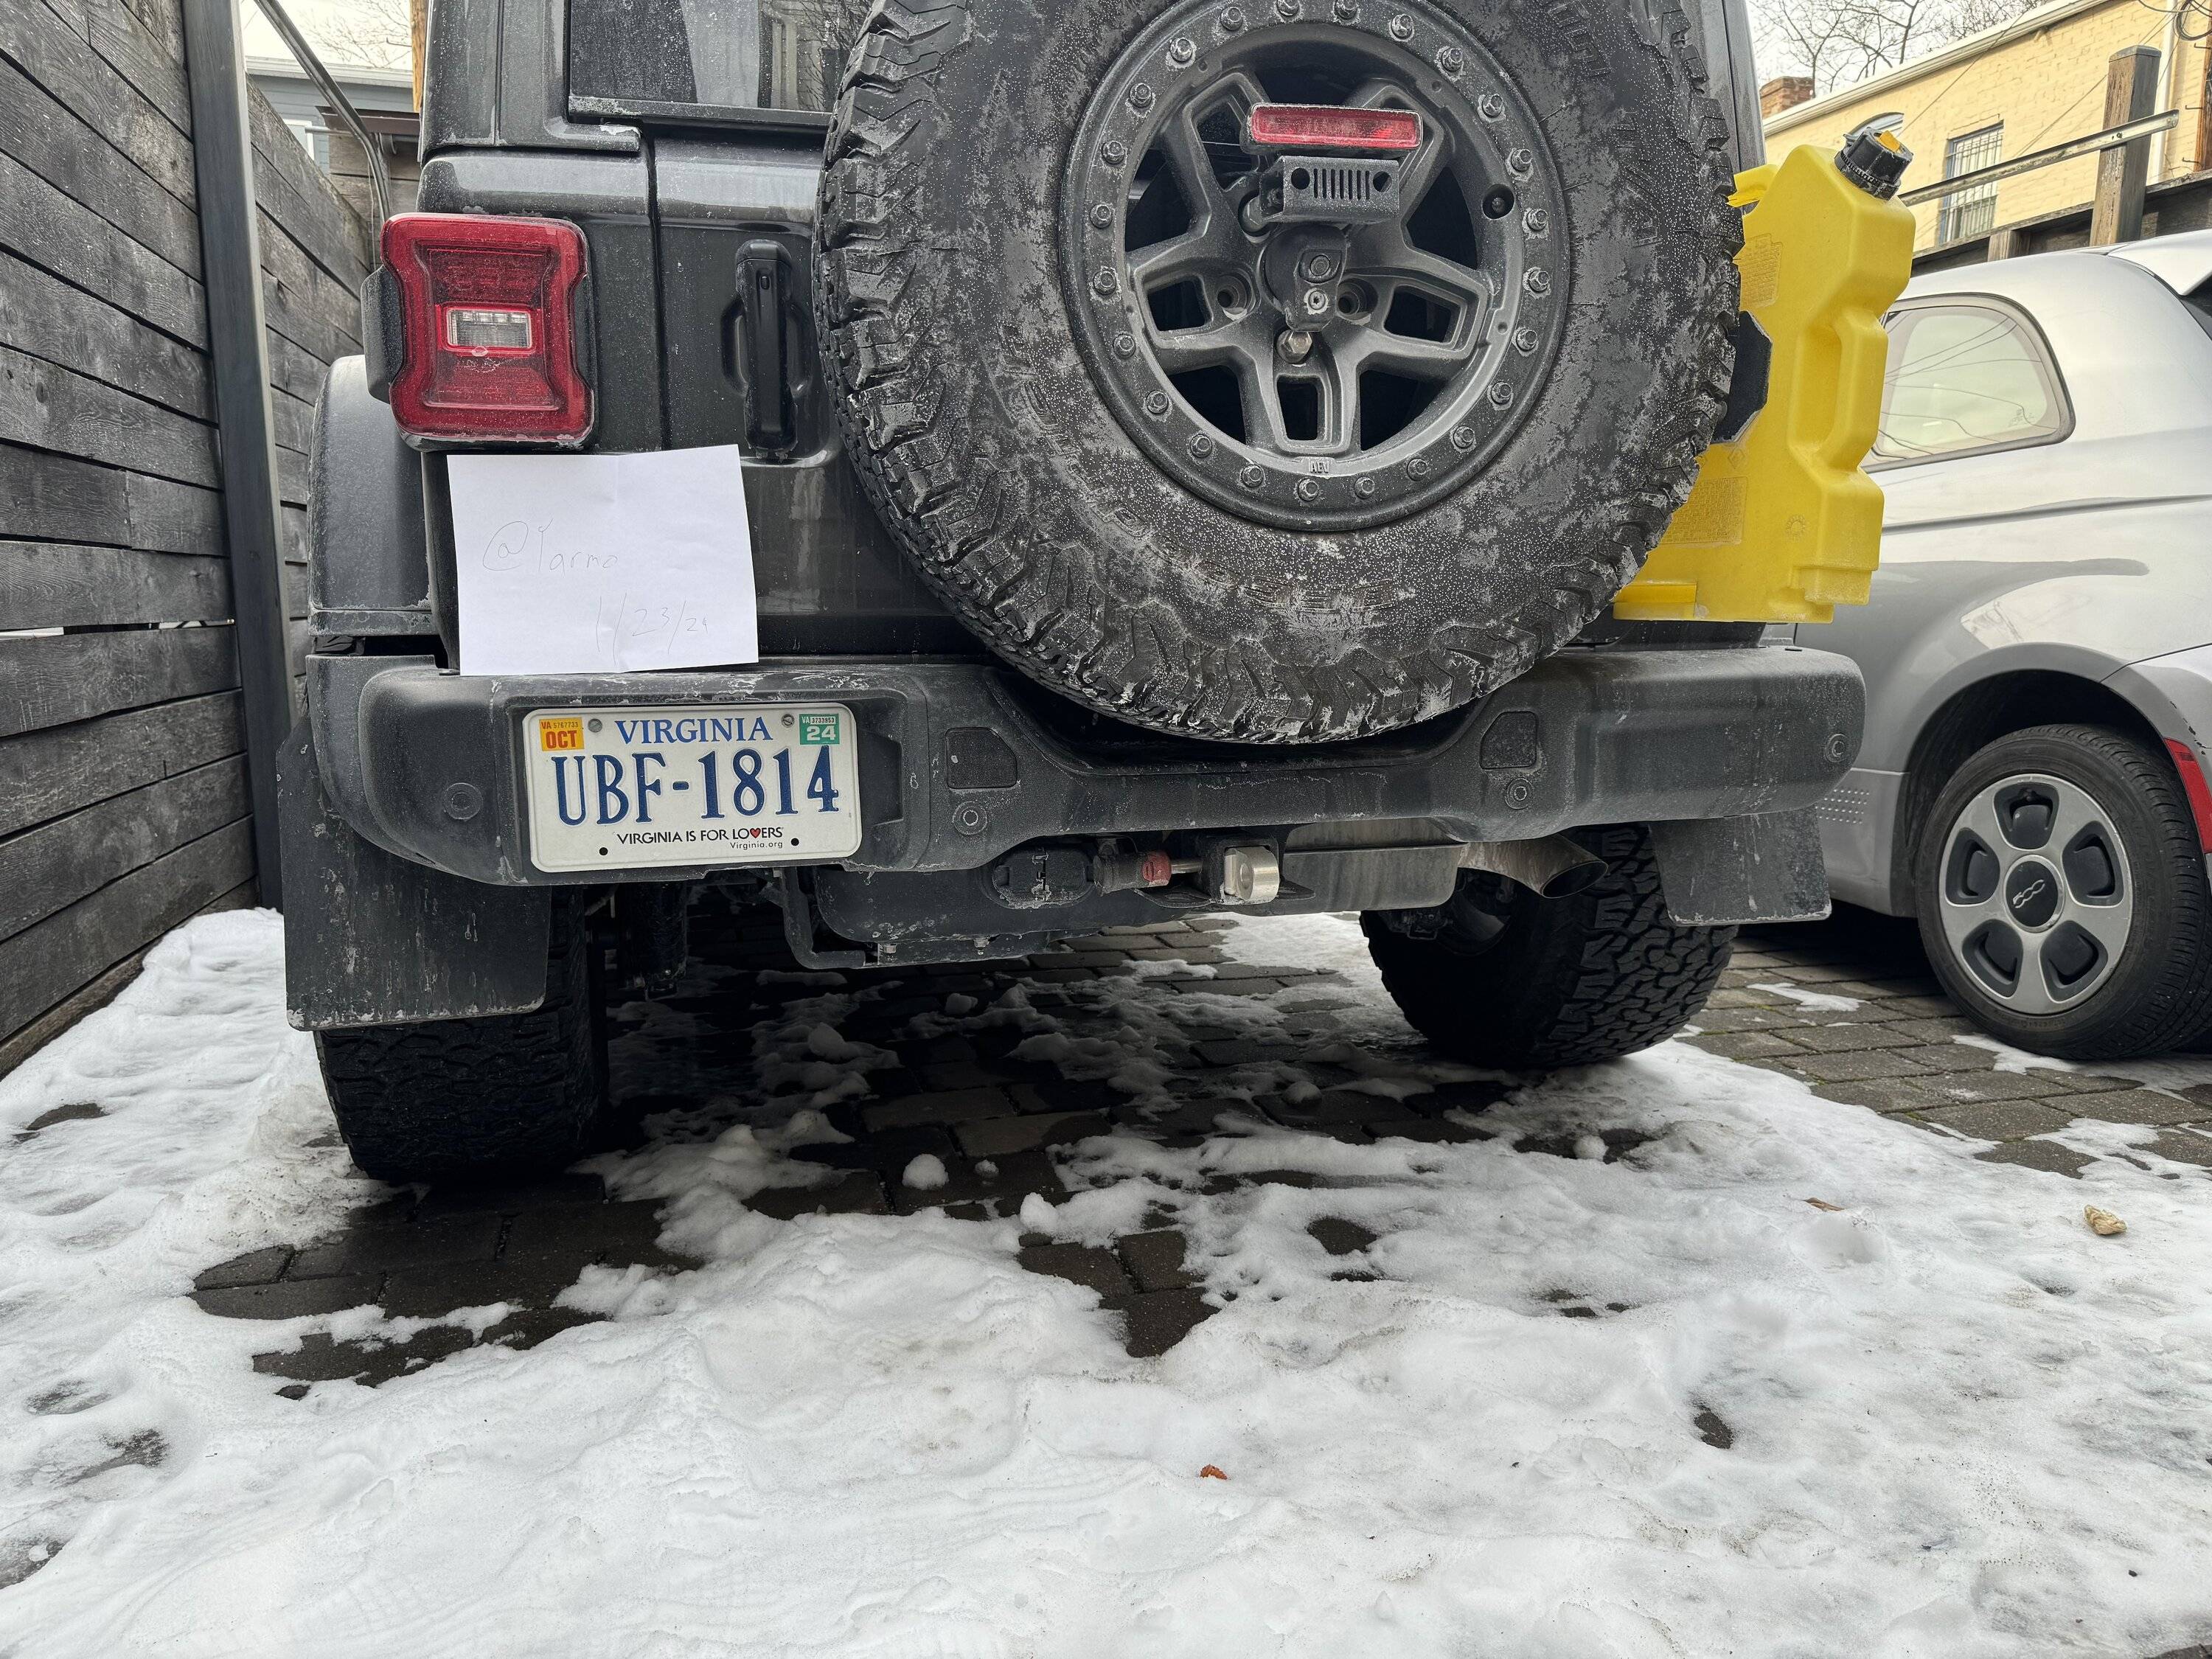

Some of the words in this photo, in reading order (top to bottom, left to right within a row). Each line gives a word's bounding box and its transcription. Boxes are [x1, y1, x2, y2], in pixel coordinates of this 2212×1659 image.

[1310, 460, 1329, 473] AEV
[541, 721, 552, 729] VA
[614, 716, 773, 745] VIRGINIA
[546, 730, 577, 748] OCT
[807, 726, 836, 741] 24
[551, 745, 840, 826] UBF-1814
[616, 831, 683, 844] VIRGINIA
[686, 830, 696, 841] IS
[700, 830, 729, 841] FOR
[729, 841, 783, 850] Virginia.org
